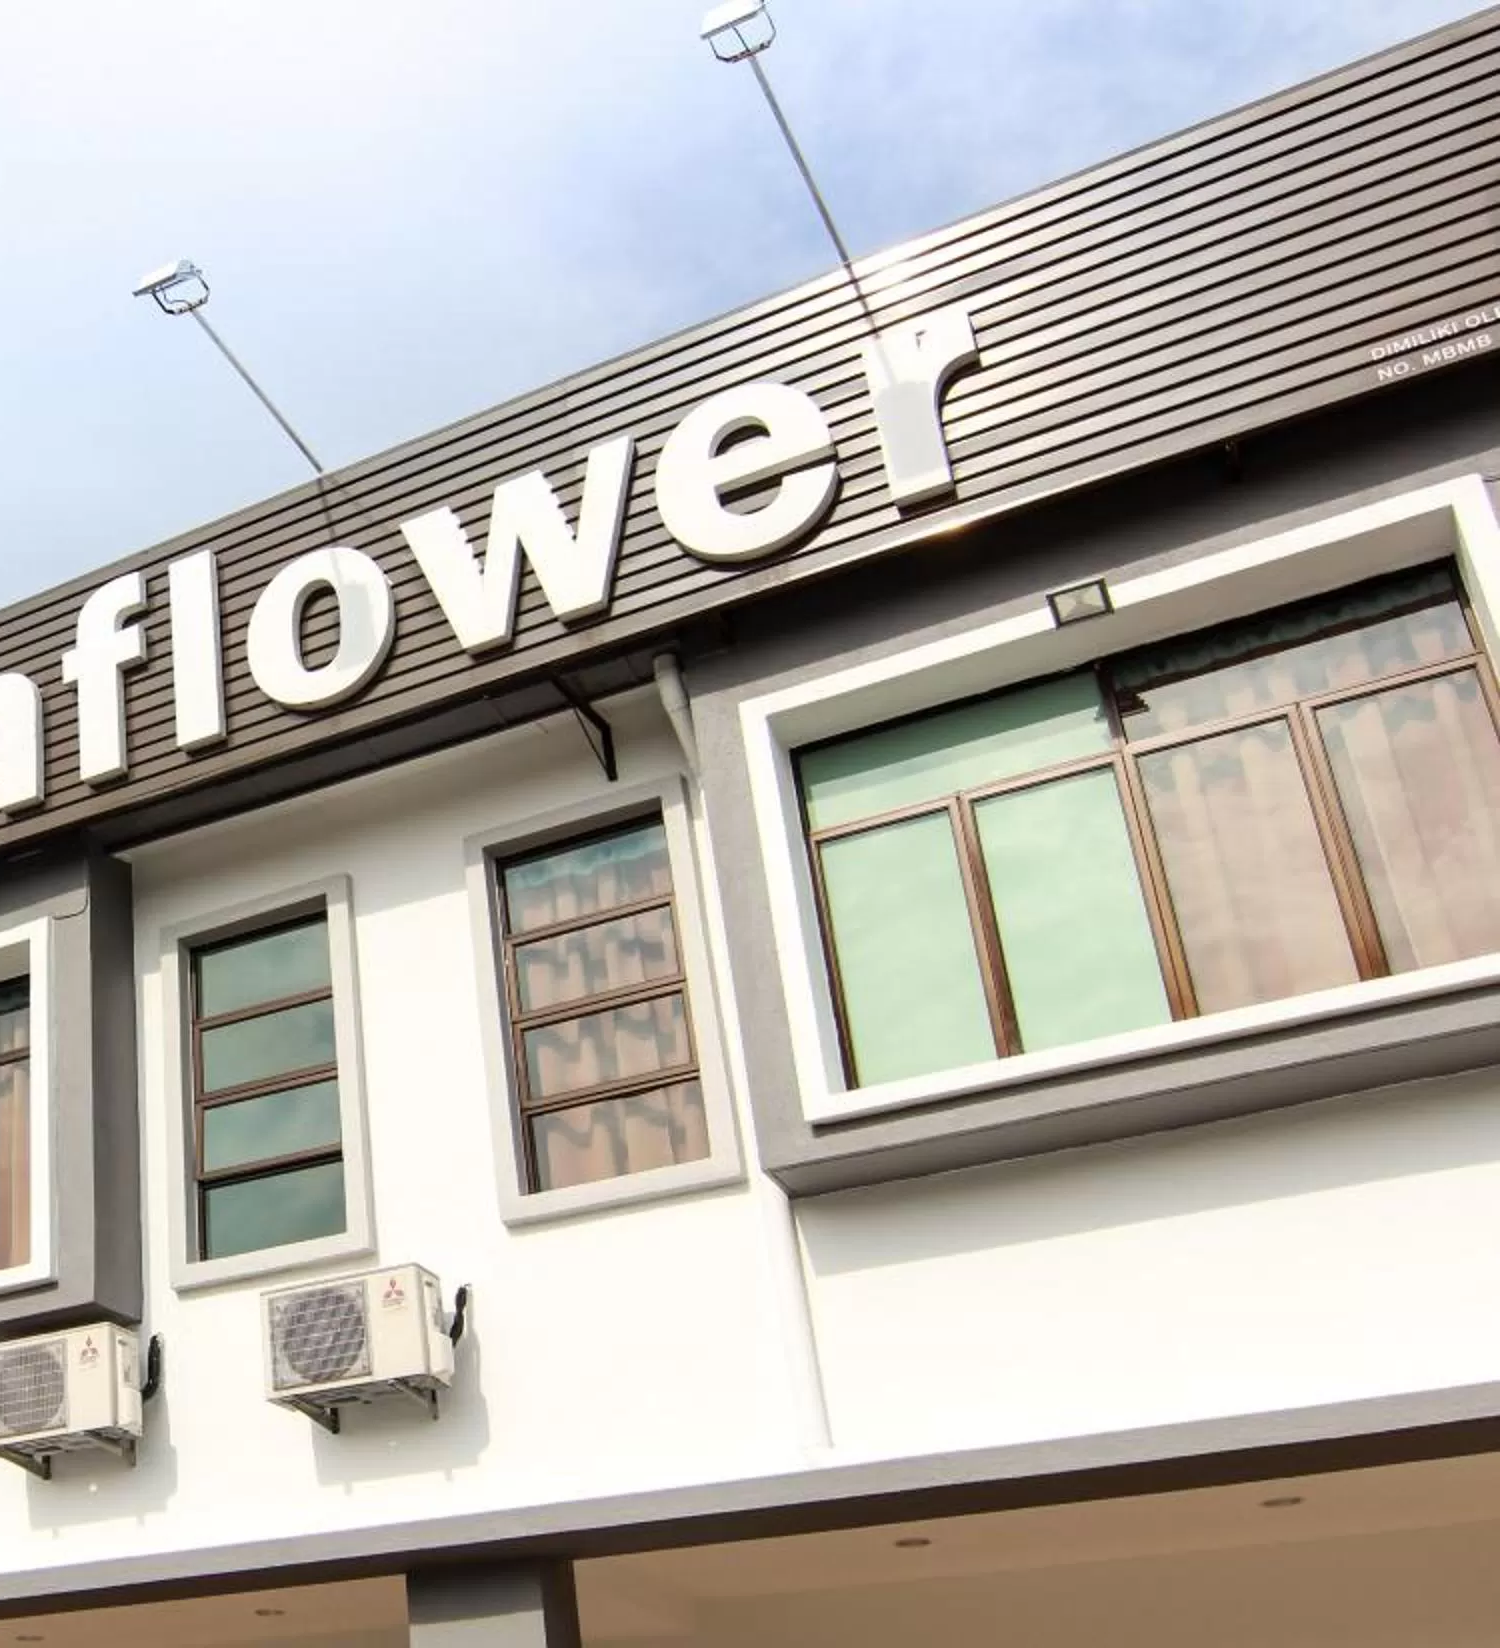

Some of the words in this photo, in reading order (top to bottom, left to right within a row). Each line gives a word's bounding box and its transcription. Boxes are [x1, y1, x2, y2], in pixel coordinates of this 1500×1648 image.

[1371, 322, 1458, 360] DIMILIKI
[1377, 361, 1417, 382] NO.
[1422, 334, 1492, 366] MBMB
